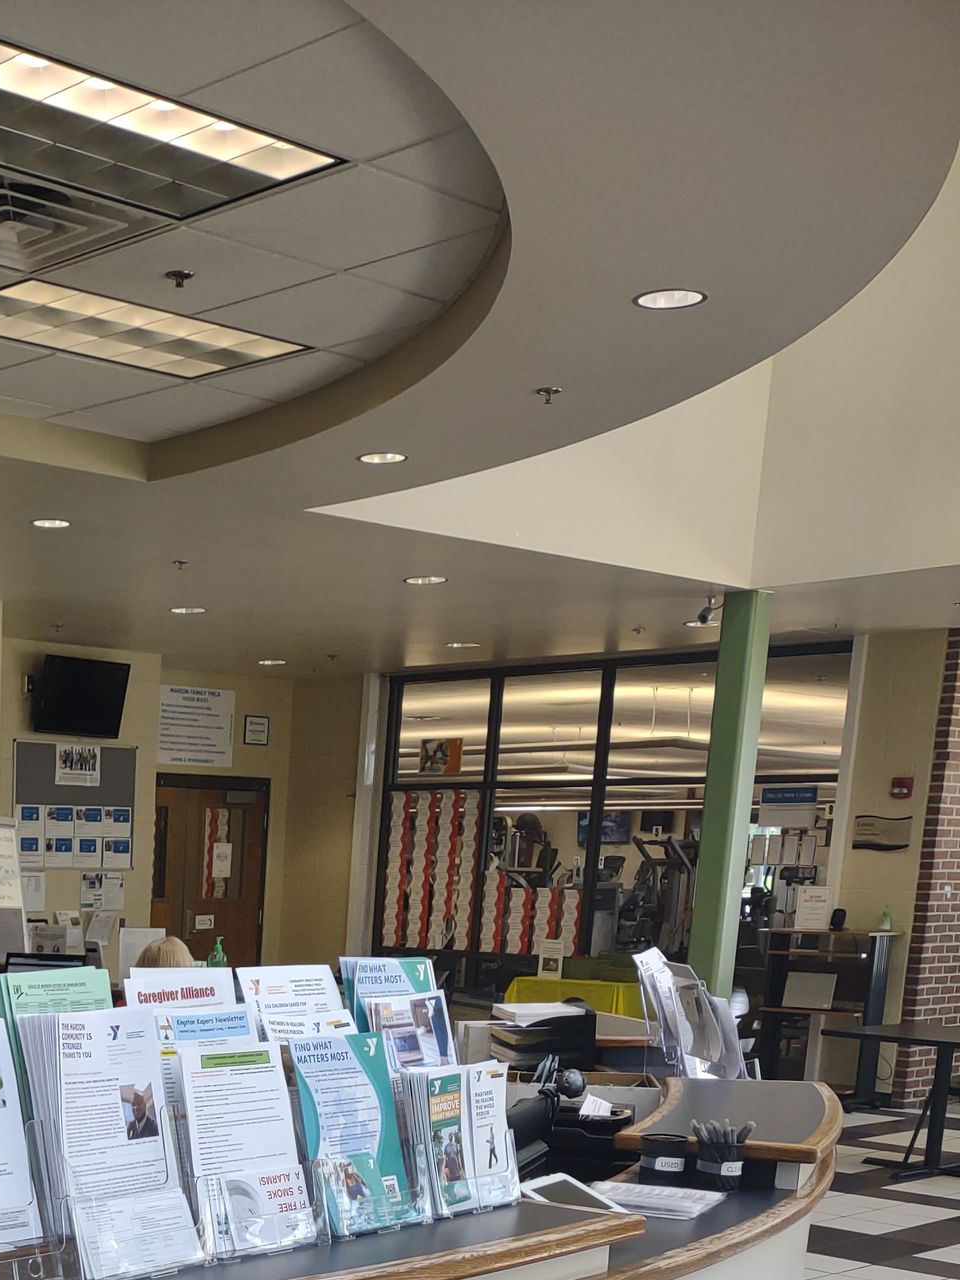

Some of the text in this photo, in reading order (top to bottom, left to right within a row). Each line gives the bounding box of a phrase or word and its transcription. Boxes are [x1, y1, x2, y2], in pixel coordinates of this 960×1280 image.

[369, 964, 386, 973] WHAT
[417, 964, 425, 980] Y
[384, 975, 405, 984] MOST.
[138, 986, 215, 1004] Caregiver Alliance
[110, 1025, 120, 1041] Y
[294, 1041, 332, 1052] FIND WHAT
[367, 1038, 377, 1056] Y
[297, 1052, 351, 1064] MATTERS MOST.
[432, 1100, 460, 1113] IMPROVE
[266, 1187, 294, 1199] SMOKE
[278, 1203, 297, 1212] FREE
